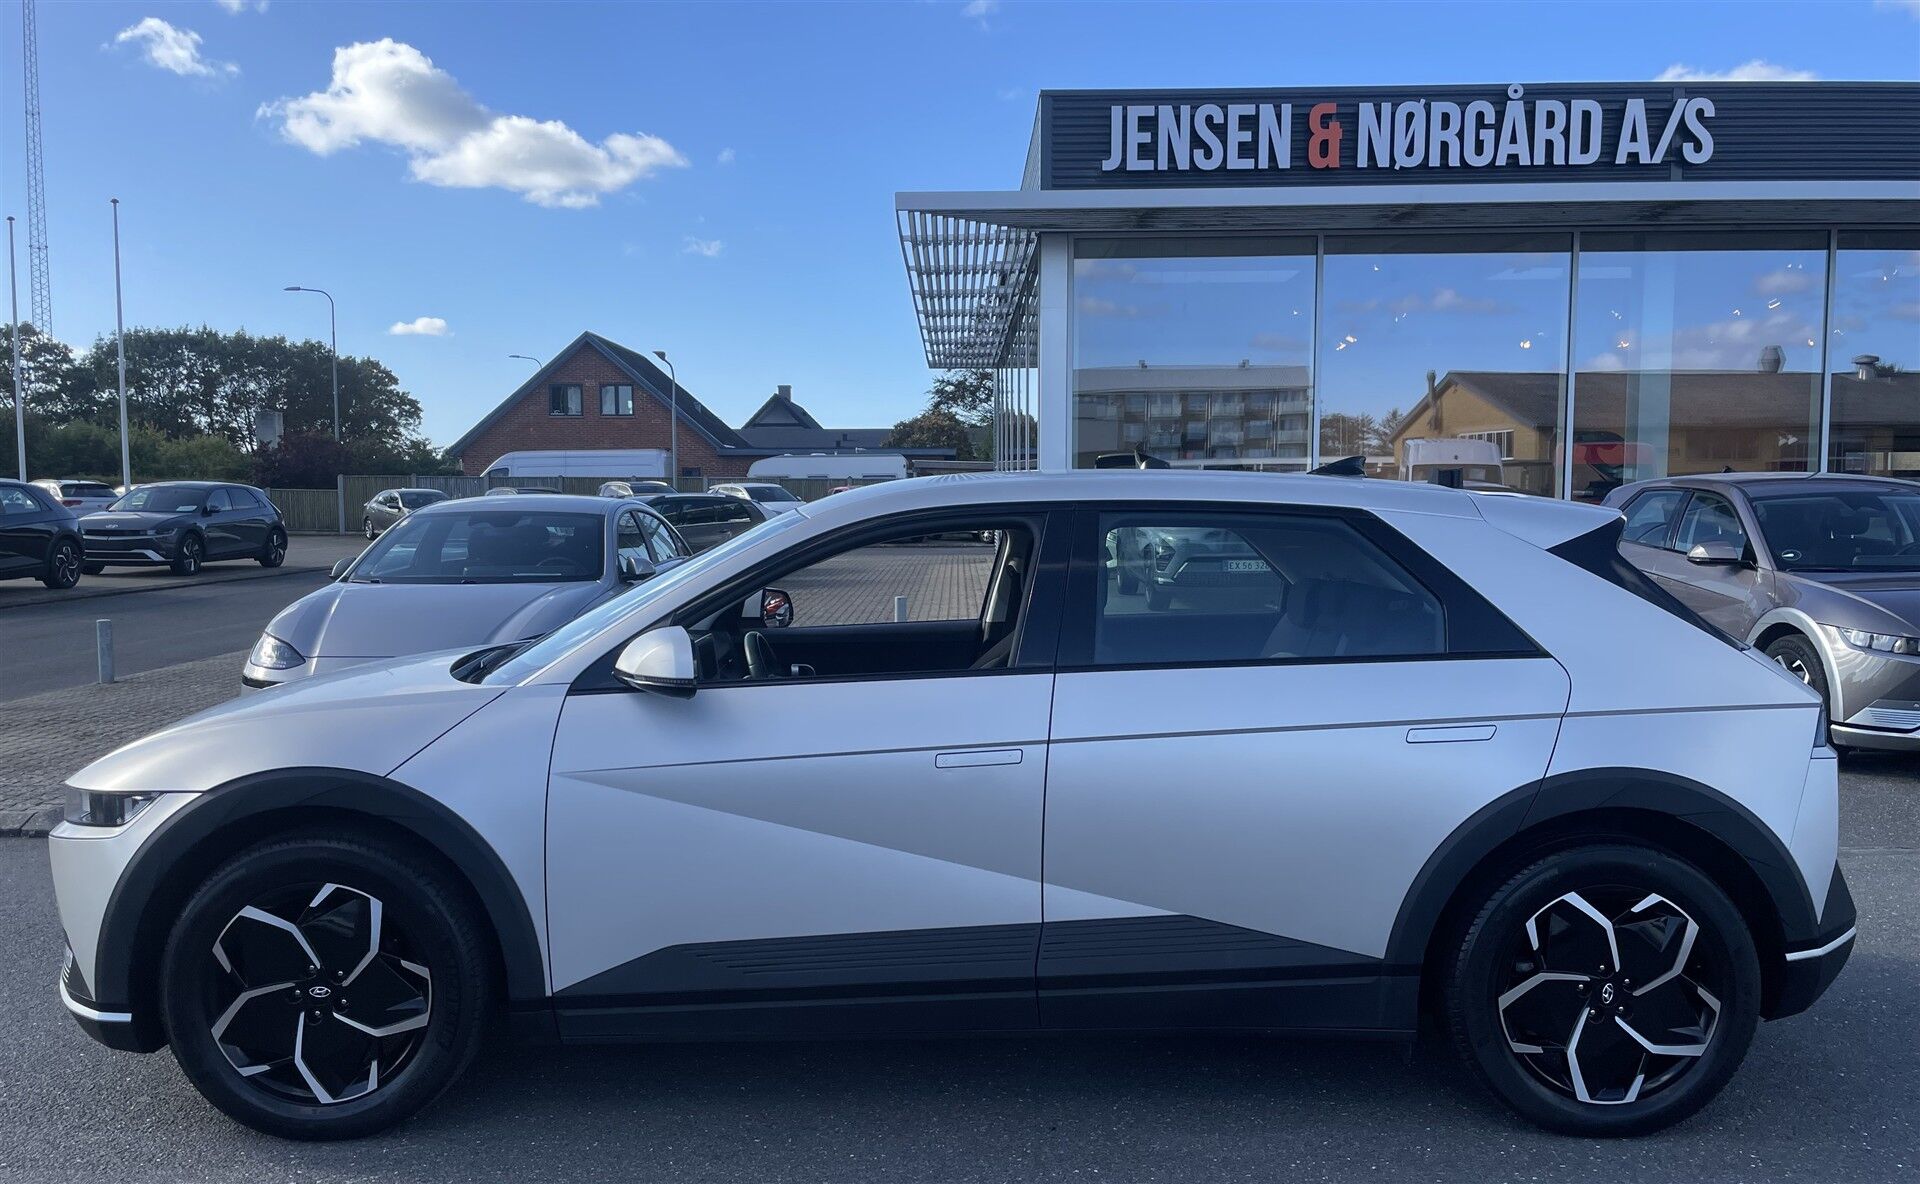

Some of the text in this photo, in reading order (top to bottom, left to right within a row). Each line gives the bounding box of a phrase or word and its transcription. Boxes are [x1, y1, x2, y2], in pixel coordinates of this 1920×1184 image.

[1101, 83, 1716, 171] JENSEN & NØRGÅRD A/S
[1229, 561, 1241, 570] EX
